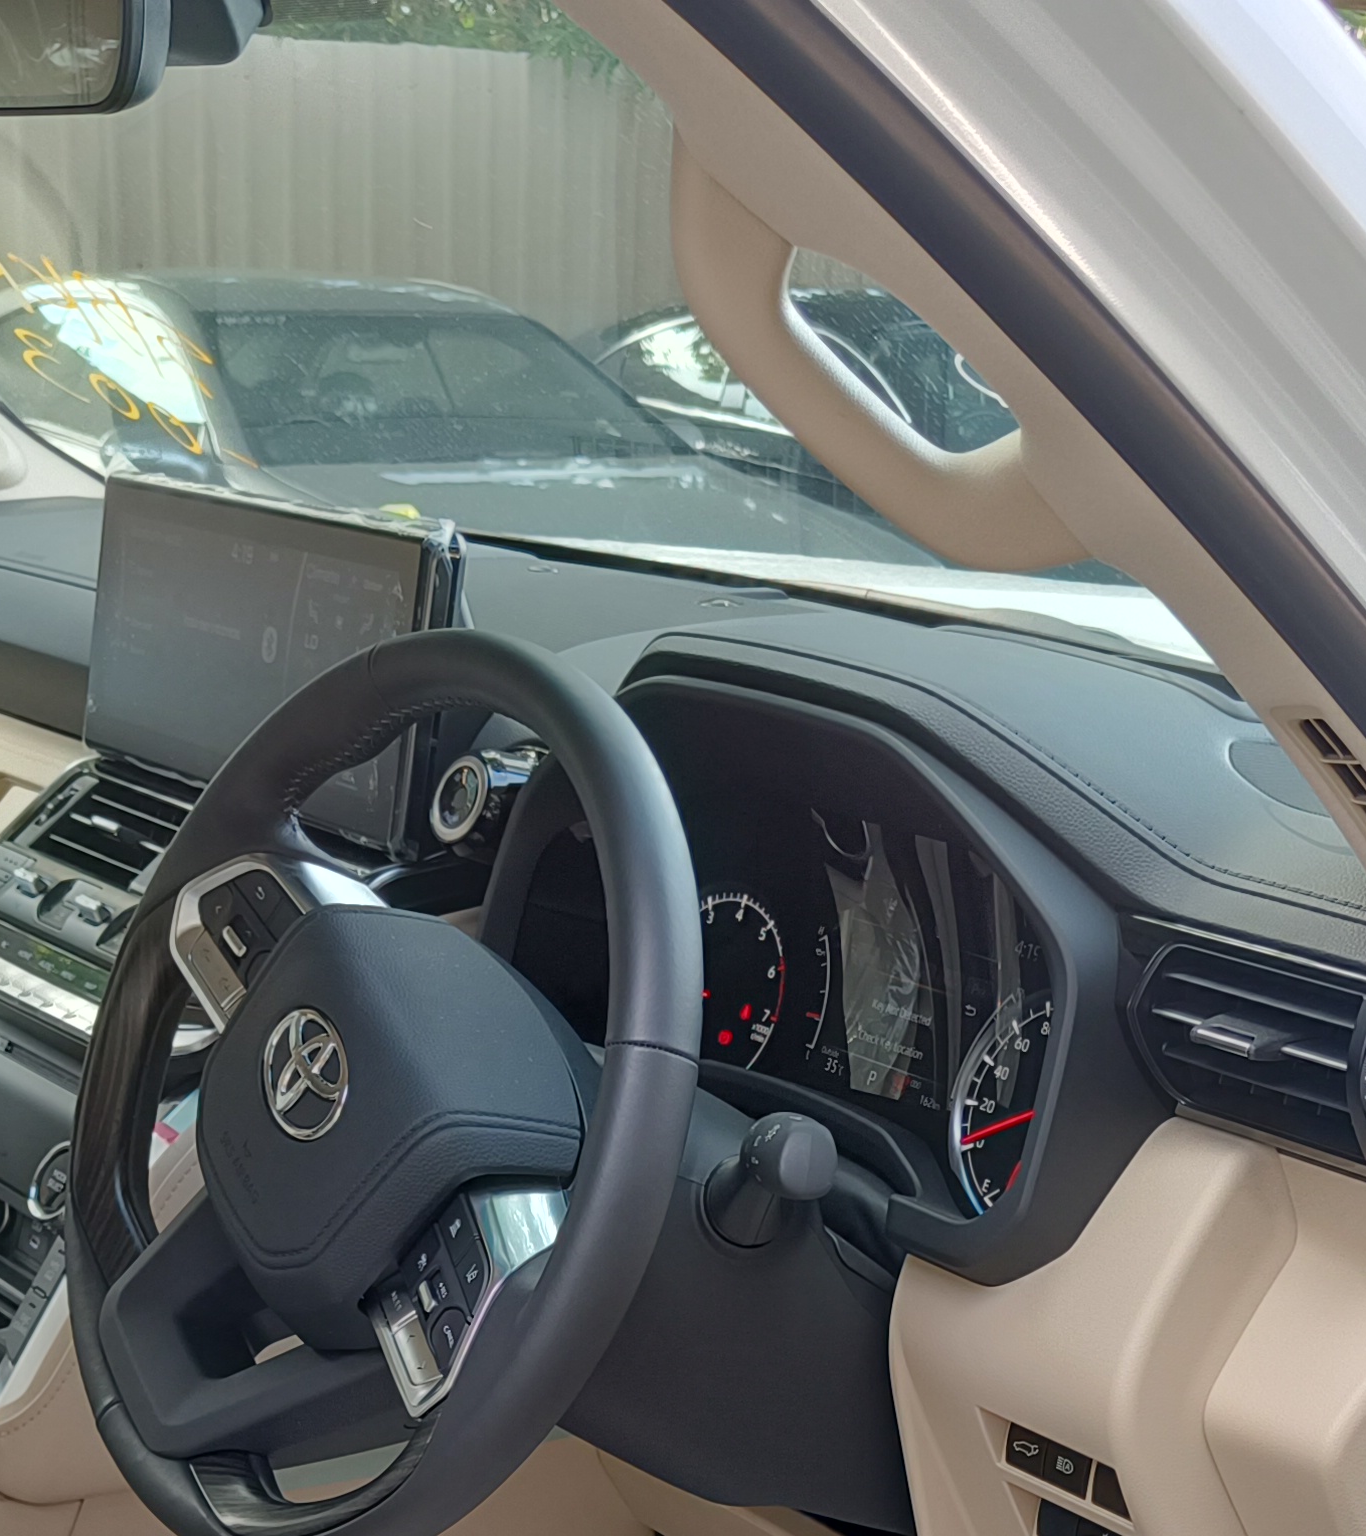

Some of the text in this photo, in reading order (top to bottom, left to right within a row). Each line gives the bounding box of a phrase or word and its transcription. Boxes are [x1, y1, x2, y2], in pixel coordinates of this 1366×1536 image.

[706, 911, 715, 924] 3
[735, 909, 745, 922] 4
[758, 928, 767, 941] 5
[767, 965, 776, 979] 6
[762, 1009, 771, 1022] 7
[1014, 1037, 1030, 1053] 60
[866, 1070, 877, 1086] P
[993, 1065, 1010, 1081] 40
[979, 1097, 996, 1114] 20
[981, 1179, 991, 1193] E
